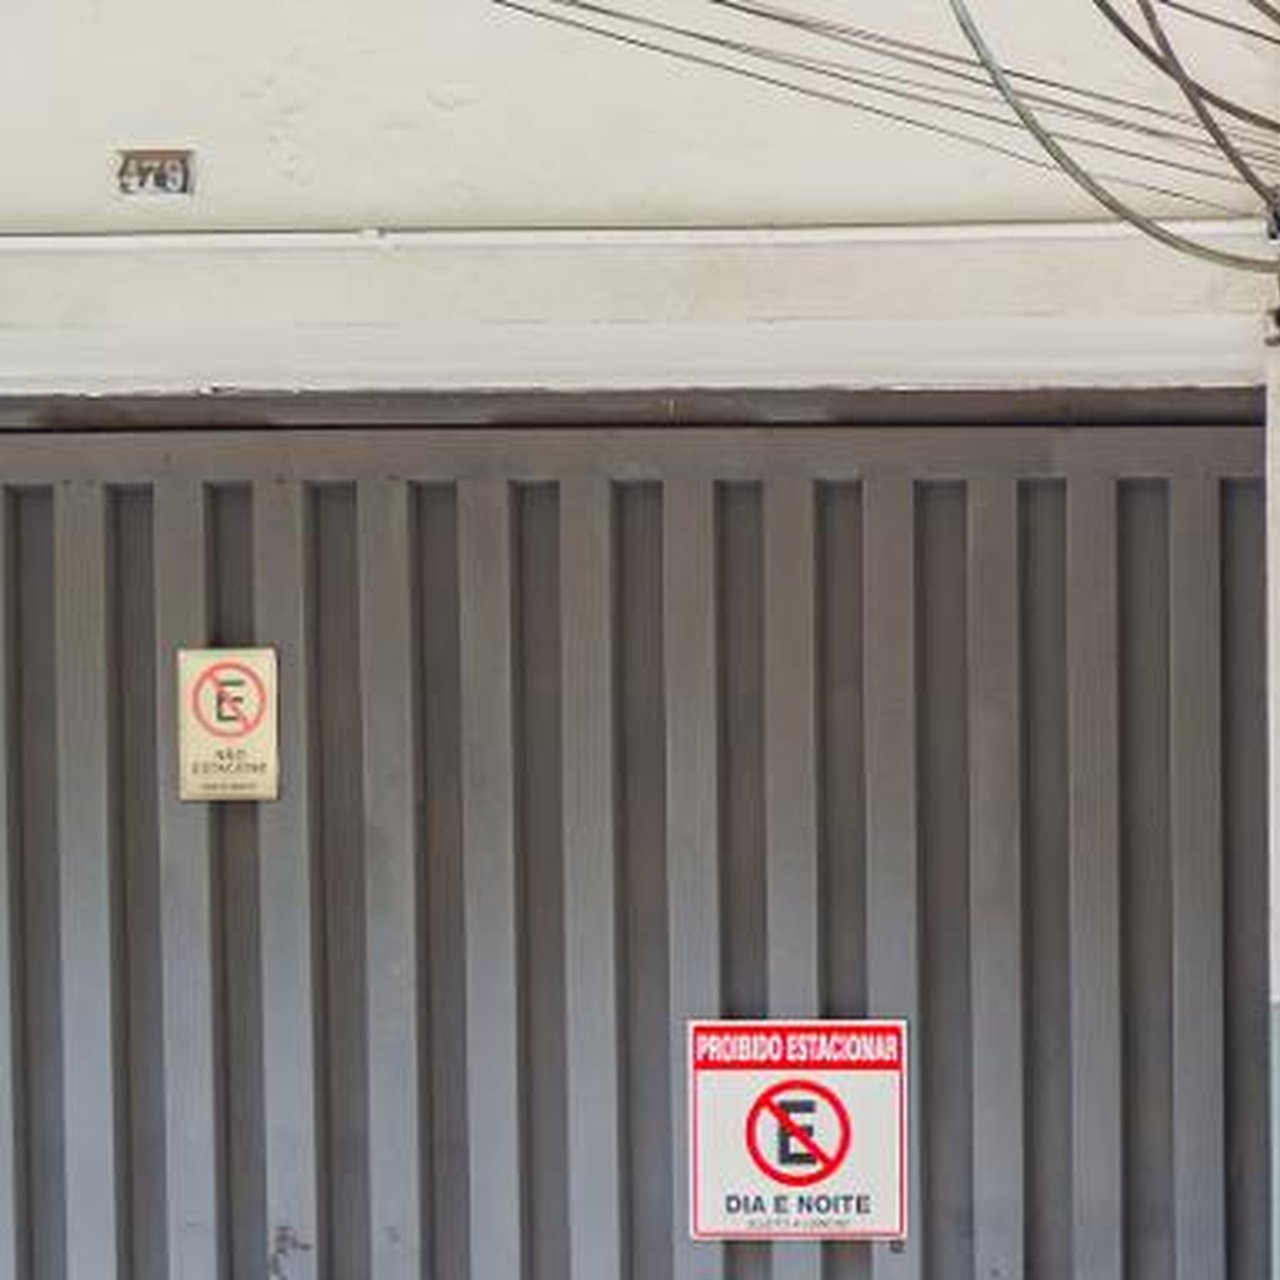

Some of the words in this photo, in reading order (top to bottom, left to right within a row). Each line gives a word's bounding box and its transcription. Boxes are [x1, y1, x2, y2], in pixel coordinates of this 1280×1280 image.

[695, 1032, 784, 1062] PROIBIDO
[786, 1032, 899, 1062] ESTACIONAR
[725, 1194, 766, 1215] DIA
[773, 1194, 789, 1215] E
[798, 1194, 872, 1215] NOITE
